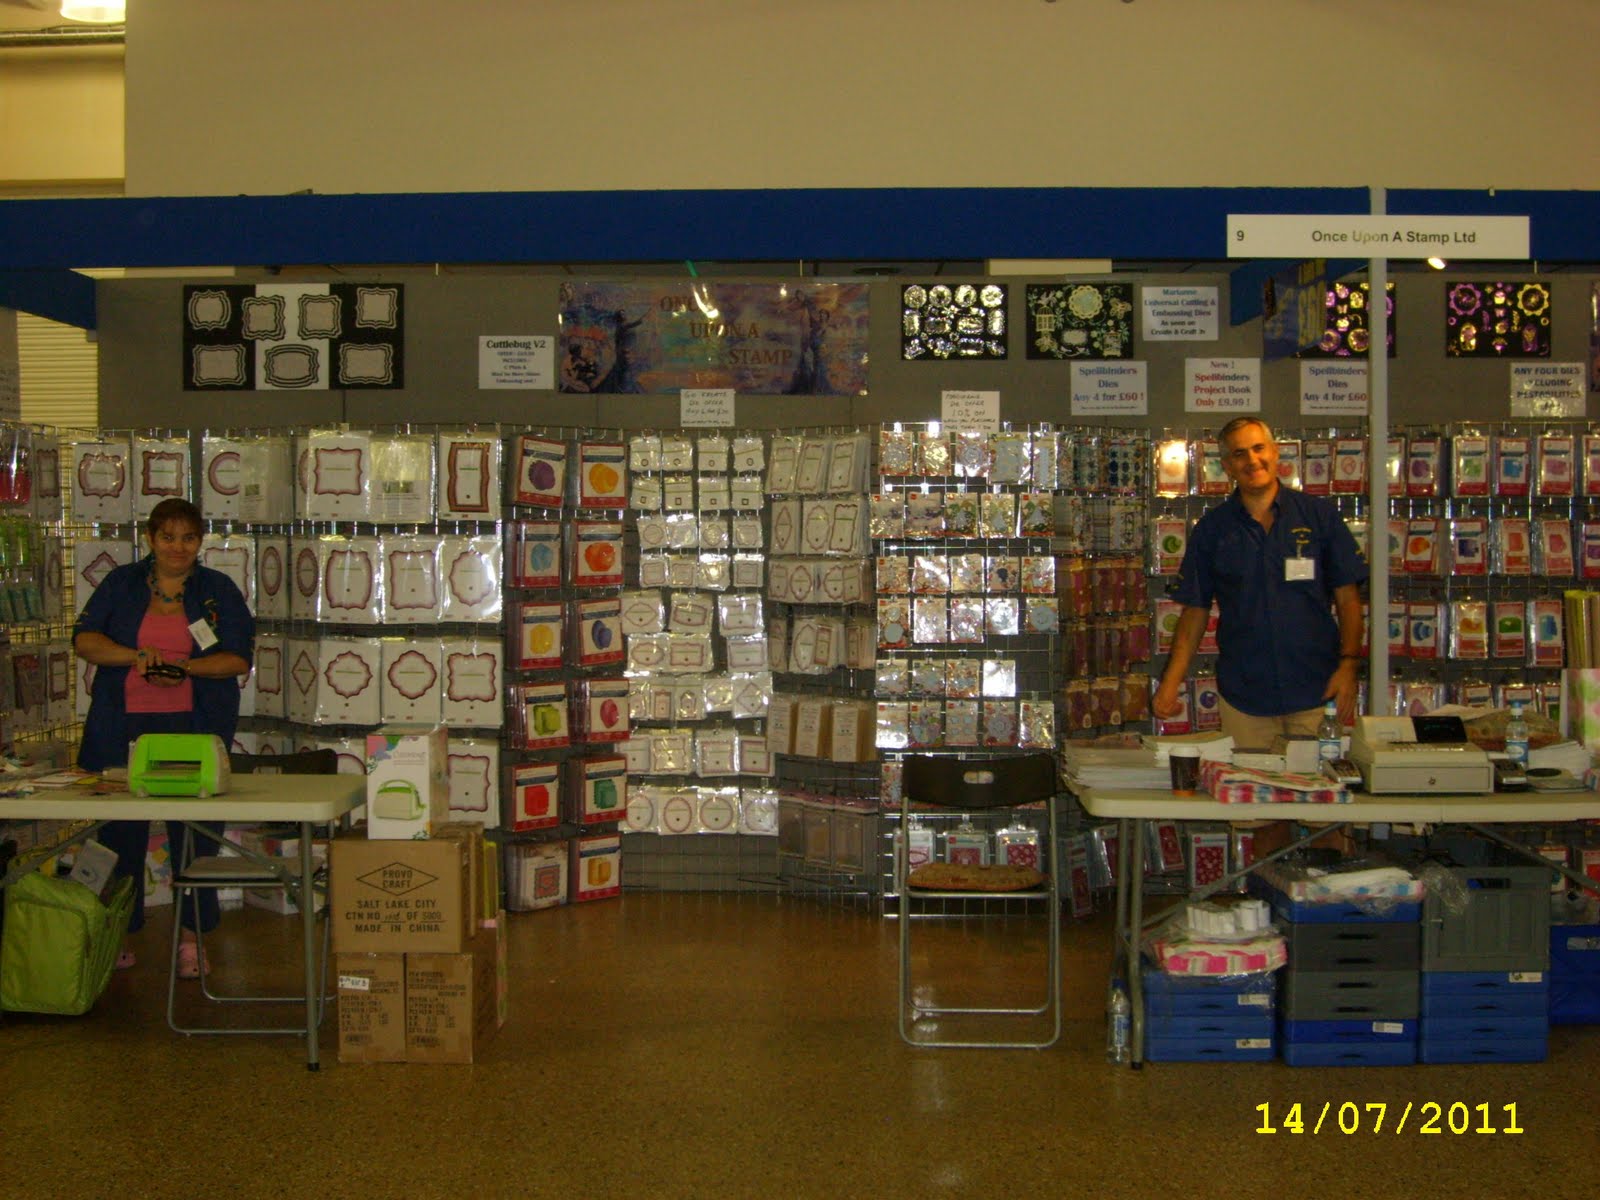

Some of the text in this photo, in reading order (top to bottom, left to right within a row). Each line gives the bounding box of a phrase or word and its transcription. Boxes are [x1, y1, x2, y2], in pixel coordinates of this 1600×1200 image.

[1236, 230, 1244, 241] 9
[1312, 230, 1475, 245] Once Upon A Stamp Ltd
[660, 296, 706, 312] ONC
[486, 340, 546, 350] Cuttlebug V2
[729, 350, 793, 365] STAMP
[1210, 361, 1228, 369] New
[1079, 366, 1137, 377] Spellbinders
[1195, 373, 1250, 382] Spellbinders
[1098, 380, 1118, 388] Dies
[1328, 380, 1348, 388] Dies
[1194, 386, 1251, 395] Project Book
[1074, 393, 1090, 402] Any
[1093, 393, 1099, 401] 4
[1103, 393, 1116, 401] for
[1119, 393, 1138, 401] £60
[1304, 393, 1319, 401] Any
[1348, 393, 1367, 401] £60
[1195, 399, 1215, 408] Only
[383, 870, 412, 879] PROVO
[382, 879, 411, 888] CRAFT
[357, 899, 436, 909] SALT LAKE CITY
[346, 912, 364, 920] CTN
[406, 912, 418, 920] OF
[355, 924, 440, 933] MADE IN CHINA
